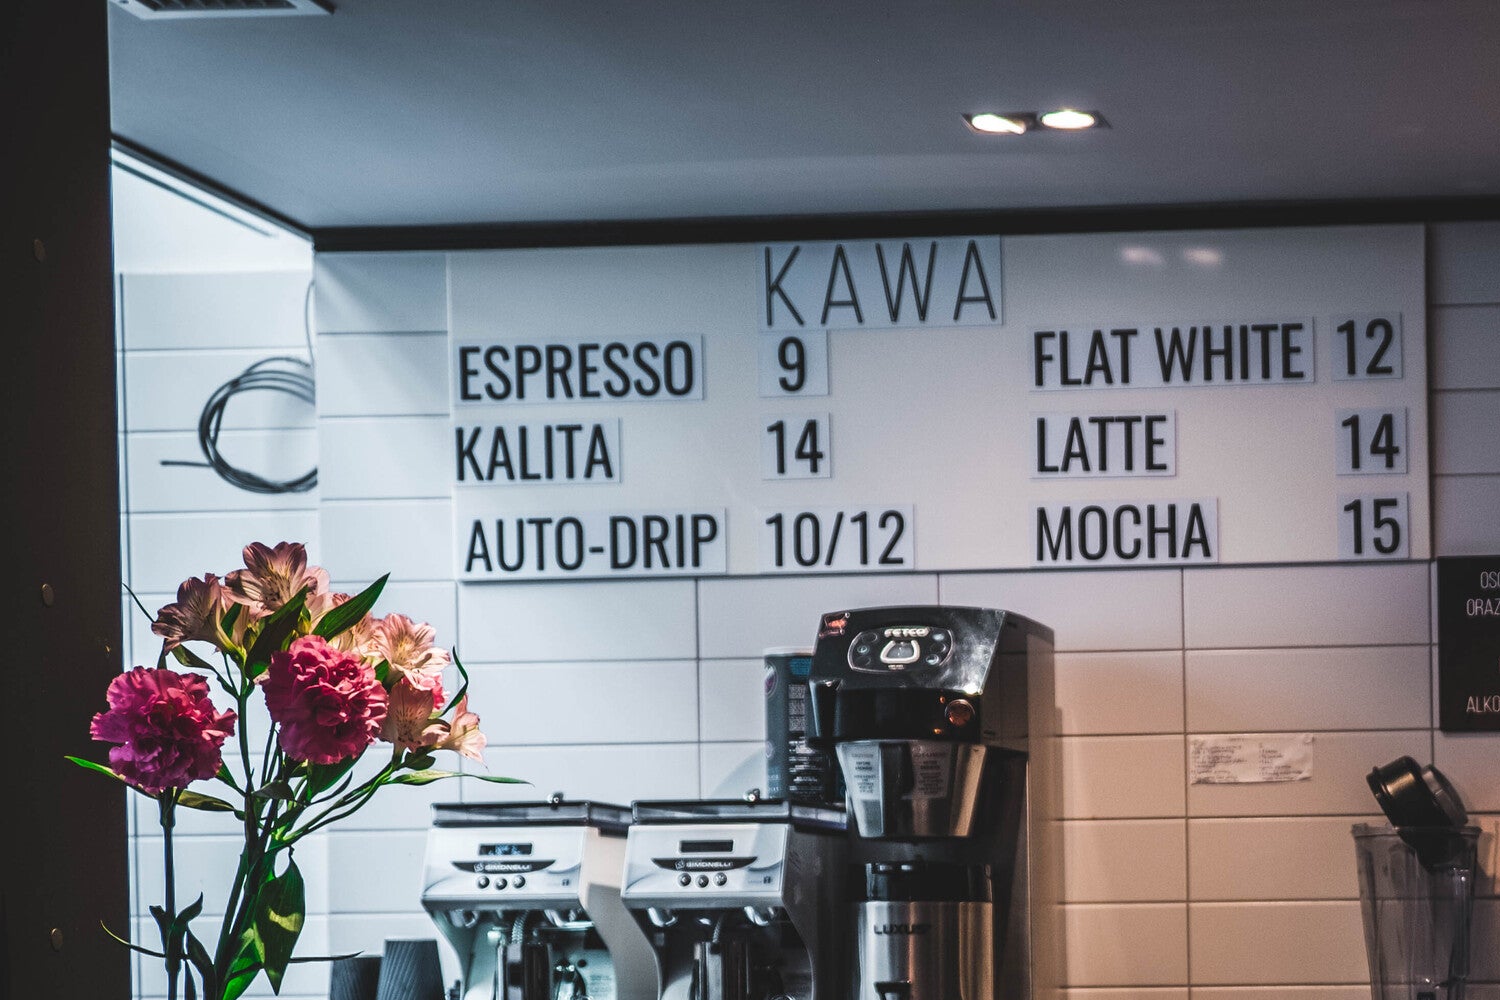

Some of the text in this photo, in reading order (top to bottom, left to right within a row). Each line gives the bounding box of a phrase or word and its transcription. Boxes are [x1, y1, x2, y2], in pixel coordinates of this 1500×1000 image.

[764, 240, 996, 326] KAWA
[458, 336, 806, 400] ESPRESSO 9
[1033, 317, 1394, 386] FLAT WHITE 12
[455, 418, 824, 481] KALITA 14
[1036, 413, 1399, 473] LATTE 14
[465, 509, 905, 573] AUTO-DRIP 10/12
[1036, 498, 1401, 561] MOCHA 15
